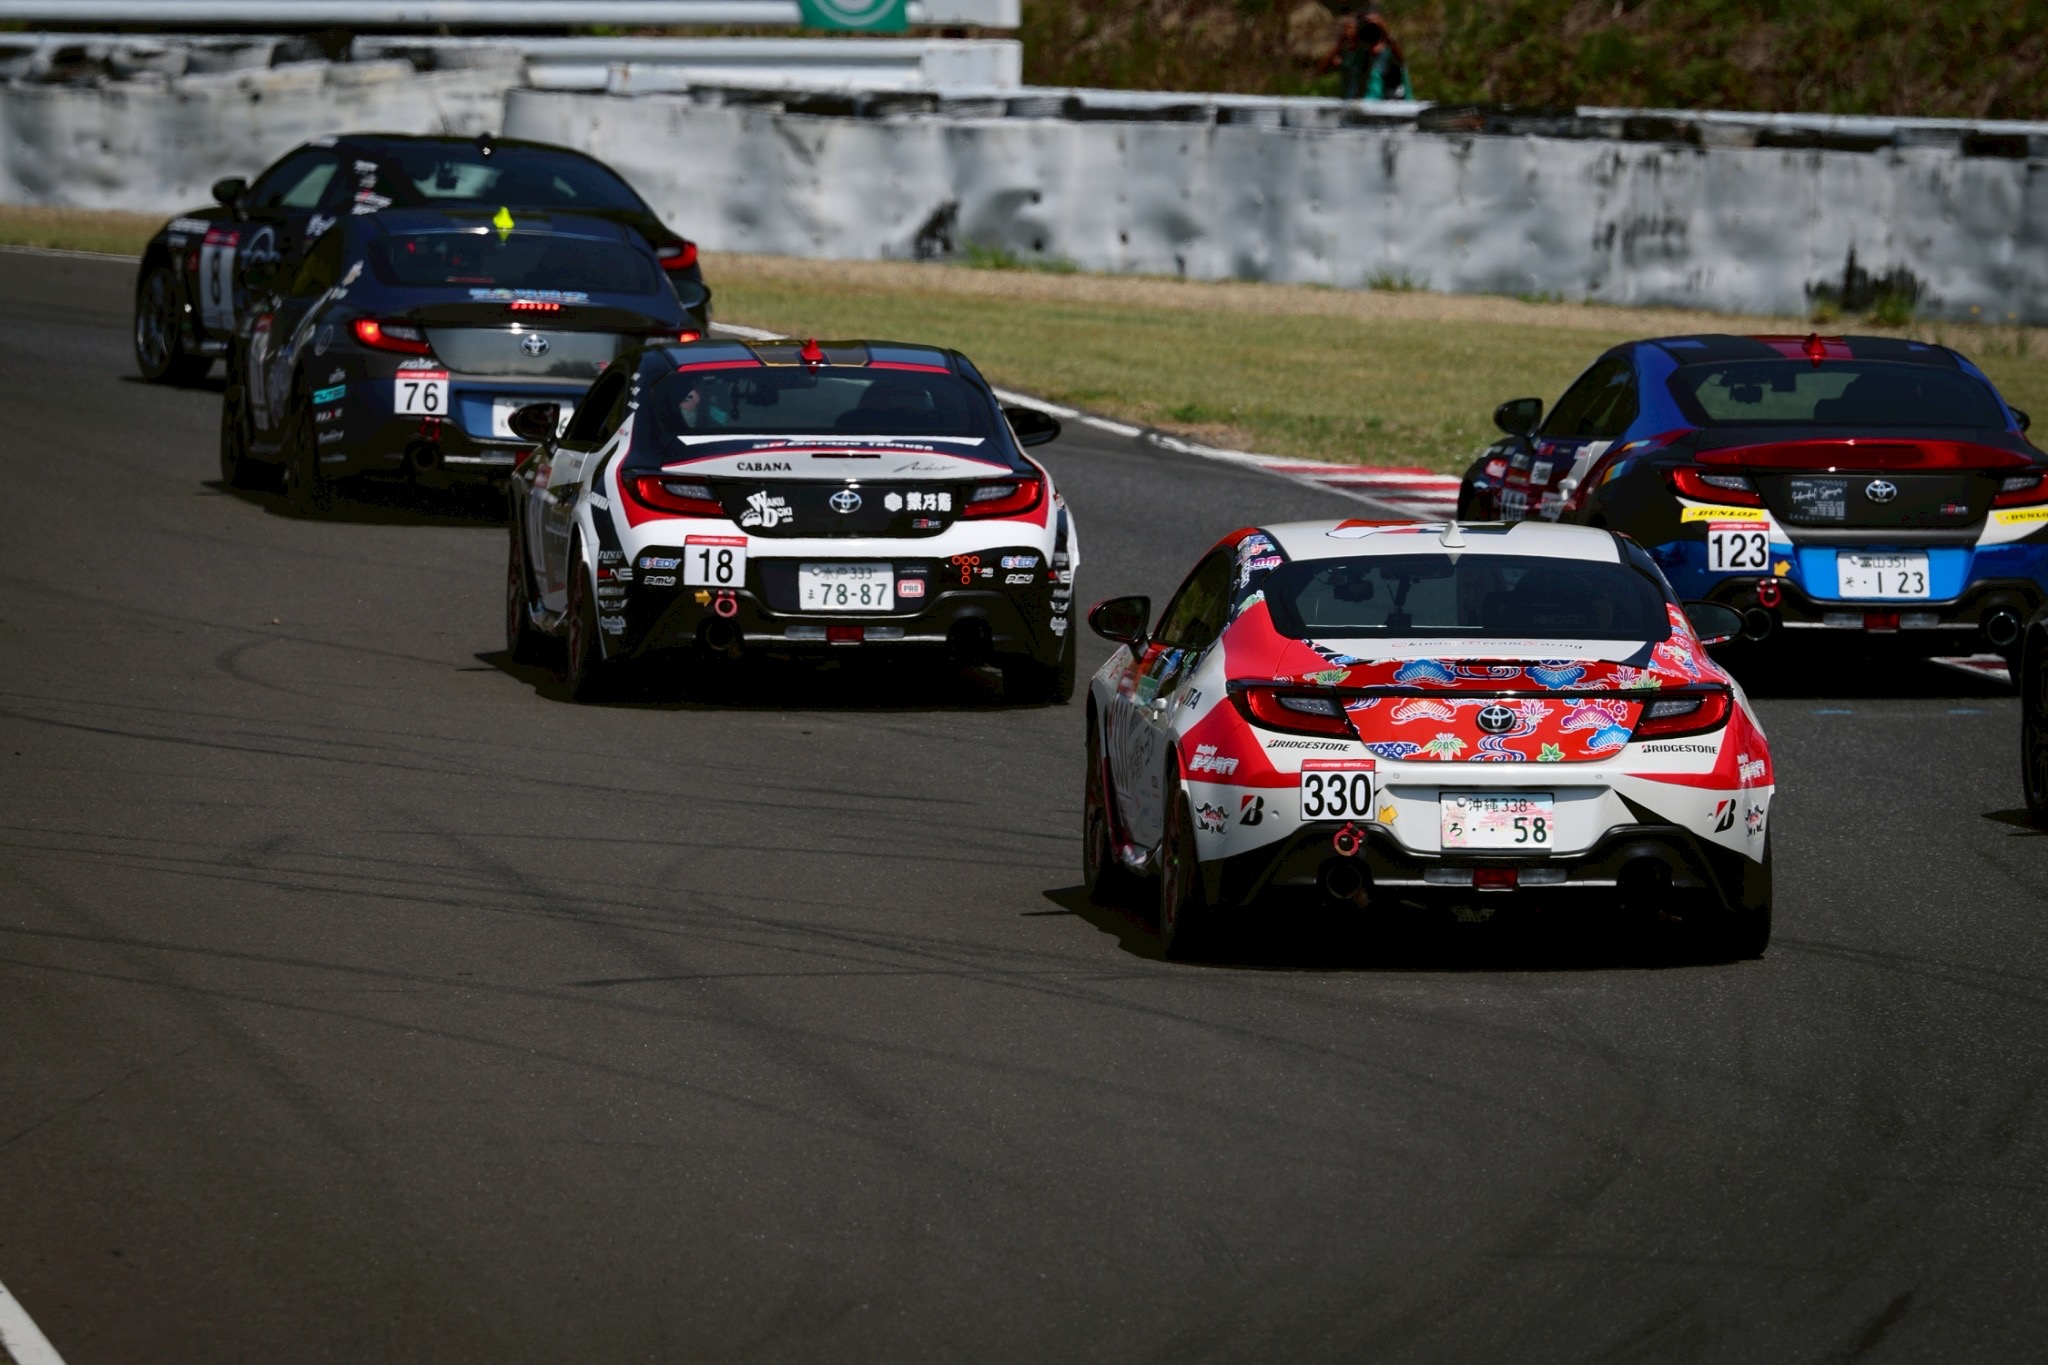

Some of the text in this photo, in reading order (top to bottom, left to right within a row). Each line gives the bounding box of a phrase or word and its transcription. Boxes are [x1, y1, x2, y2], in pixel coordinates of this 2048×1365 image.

[404, 383, 438, 411] 76
[736, 461, 792, 472] CABANA
[1697, 510, 1757, 518] DUNLOP
[1712, 533, 1766, 568] 123
[639, 557, 682, 569] EXEDY
[698, 548, 732, 583] 18
[1001, 556, 1039, 569] EXEDY
[819, 583, 887, 606] 78-87
[1266, 739, 1351, 752] BRIDGESTONE
[1641, 743, 1718, 755] BRIDGESTONE
[1303, 773, 1372, 817] 330
[1449, 822, 1463, 837] ろ
